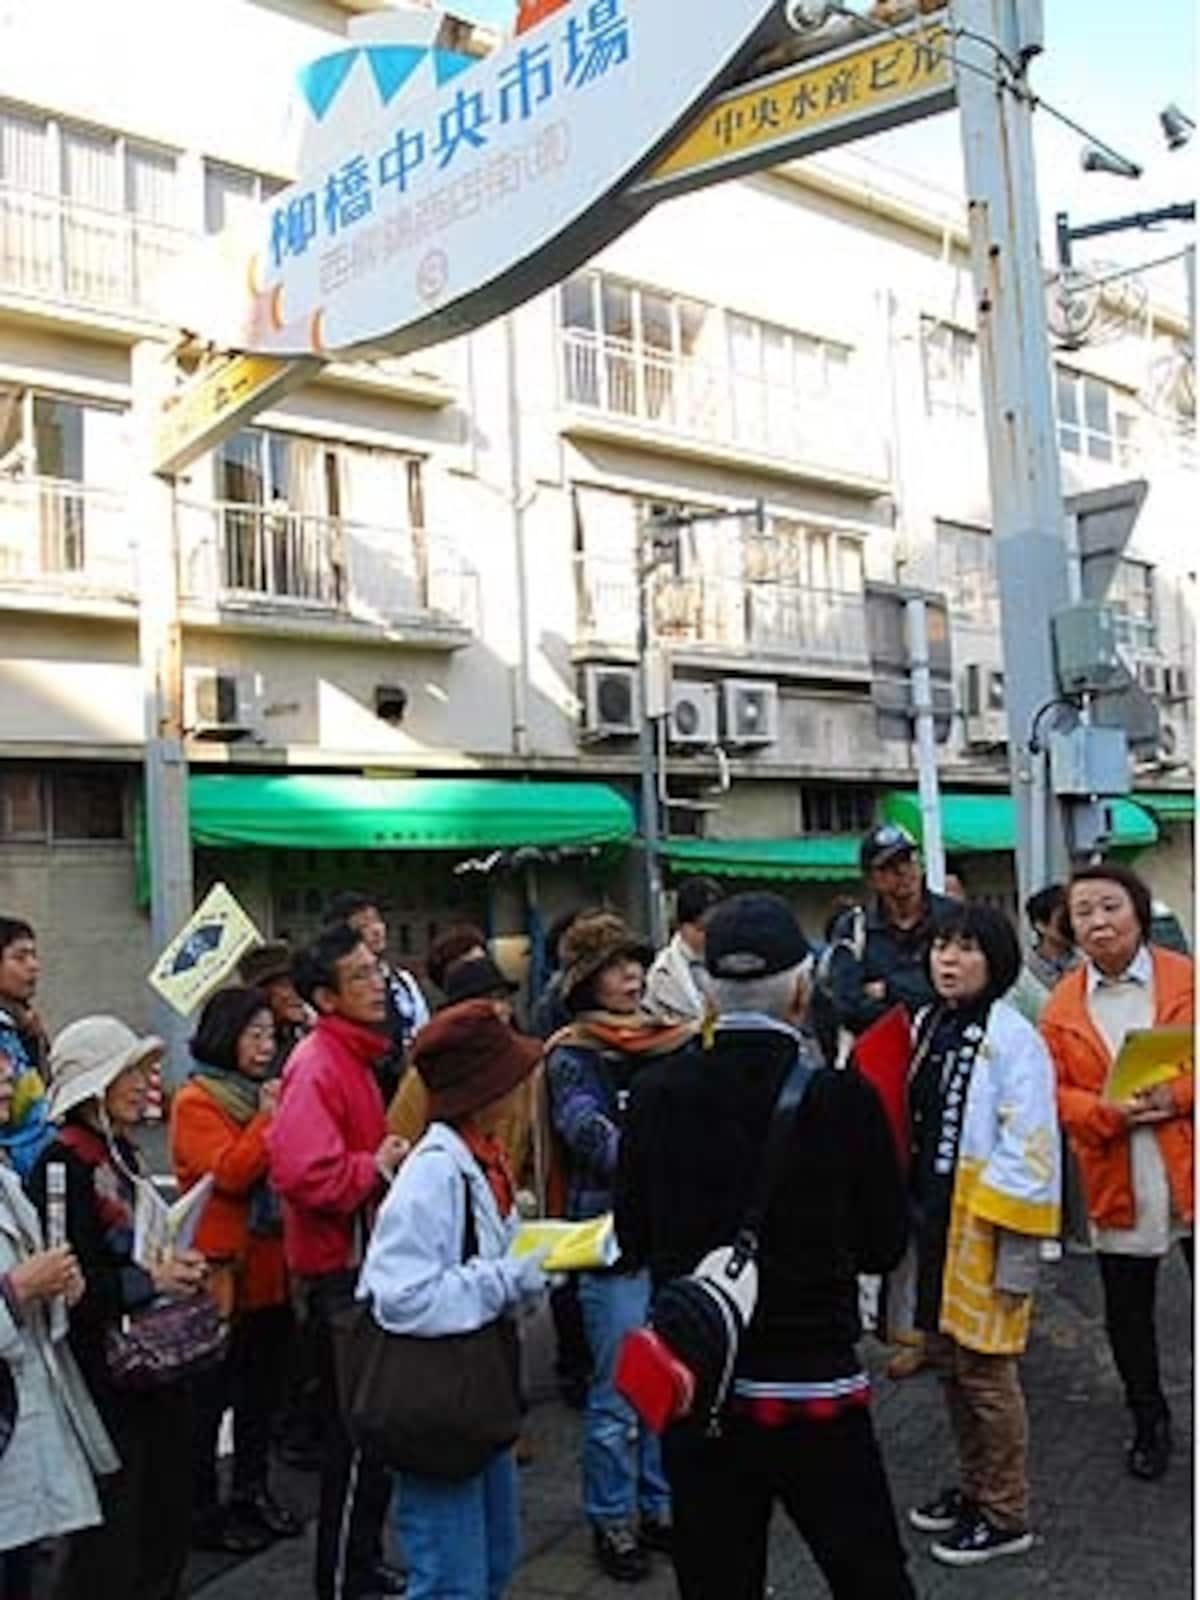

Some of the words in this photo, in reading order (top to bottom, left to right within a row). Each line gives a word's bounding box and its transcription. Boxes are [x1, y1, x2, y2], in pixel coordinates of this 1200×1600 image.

[270, 0, 630, 267] 柳橋中央市場
[714, 36, 943, 145] 中央水産ビル
